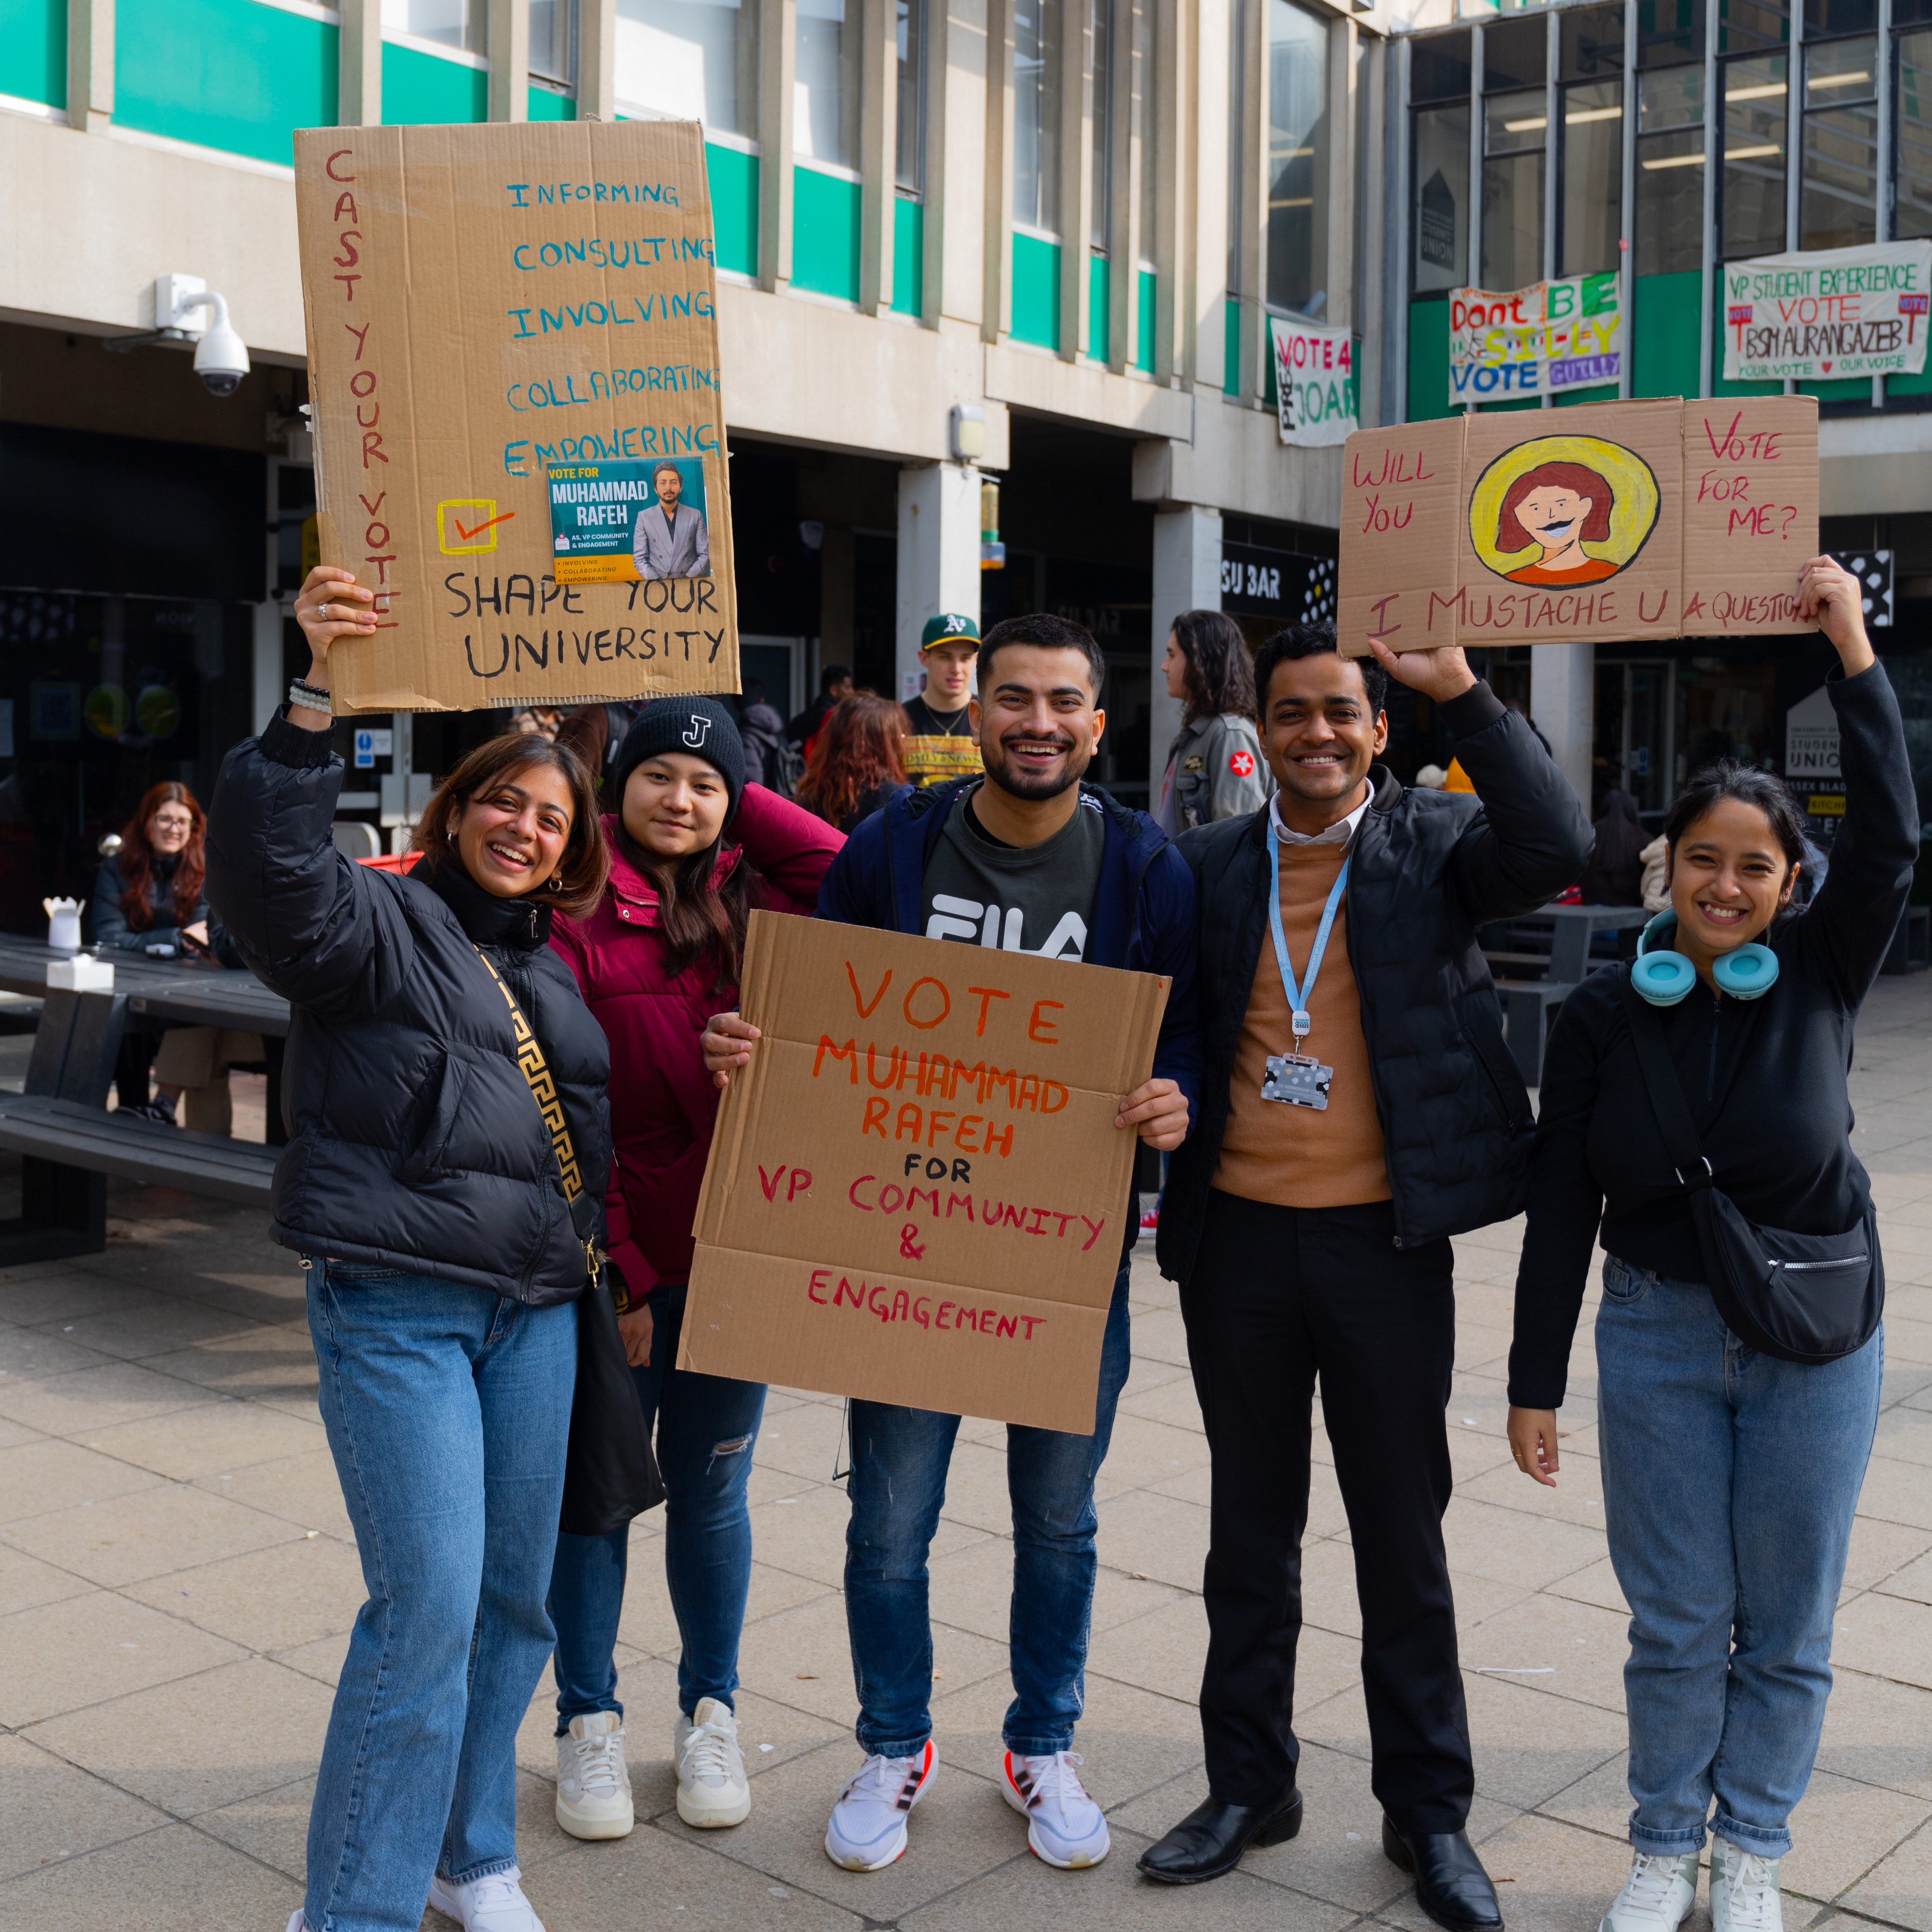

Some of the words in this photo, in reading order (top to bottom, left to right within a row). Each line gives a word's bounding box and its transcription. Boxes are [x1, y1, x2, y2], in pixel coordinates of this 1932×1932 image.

[507, 183, 679, 208] INFORMING
[326, 150, 361, 301] CAST
[514, 238, 715, 270] CONSULTING
[1548, 270, 1618, 319] BE
[1730, 275, 1749, 300] VP
[1753, 270, 1813, 300] STUDENT
[1819, 264, 1917, 295] EXPERIENCE
[508, 292, 715, 338] INVOLVING
[1729, 308, 1753, 320] VOTE
[1778, 294, 1861, 324] VOTE
[1899, 296, 1927, 311] VOTE
[1278, 334, 1333, 370] VOTE
[1484, 314, 1620, 367] SILLY
[1782, 320, 1903, 356] AURANGAZEB
[1451, 361, 1537, 392] VOTE
[1739, 364, 1770, 377] YOUR
[1773, 362, 1813, 375] VOTE
[1840, 358, 1863, 371] OUR
[1867, 355, 1906, 369] VOICE
[346, 323, 388, 468] YOUR
[508, 365, 721, 411] COLLABORATING
[1277, 351, 1296, 430] PREZ
[504, 424, 719, 477] EMPOWERING
[1352, 448, 1435, 488] WILL
[548, 469, 576, 480] VOTE
[578, 467, 599, 478] FOR
[552, 480, 648, 504] MUHAMMAD
[1697, 470, 1749, 503] FOR
[577, 504, 628, 526] RAFEH
[1728, 505, 1797, 540] ME?
[359, 491, 401, 628] VOTE
[444, 572, 584, 617] SHAPE
[624, 579, 718, 615] YOUR
[1221, 560, 1244, 595] SU
[1247, 564, 1280, 600] BAR
[1366, 593, 1400, 638] I
[1428, 586, 1617, 632] MUSTACHE
[1638, 589, 1669, 623] U
[1682, 592, 1706, 620] A
[465, 627, 725, 679] UNIVERSITY
[683, 715, 711, 747] J
[1790, 740, 1837, 750] STUDEN
[1790, 752, 1840, 767] UNIO
[926, 894, 1087, 963] FILA
[845, 960, 1064, 1044] VOTE
[813, 1034, 1069, 1114] MUHAMMAD
[862, 1096, 1013, 1157] RAFEH
[904, 1153, 971, 1184] FOR
[757, 1164, 813, 1203] VP
[849, 1175, 1104, 1251] COMMUNITY
[899, 1223, 927, 1260] &
[807, 1269, 1047, 1341] ENGAGEMENT
